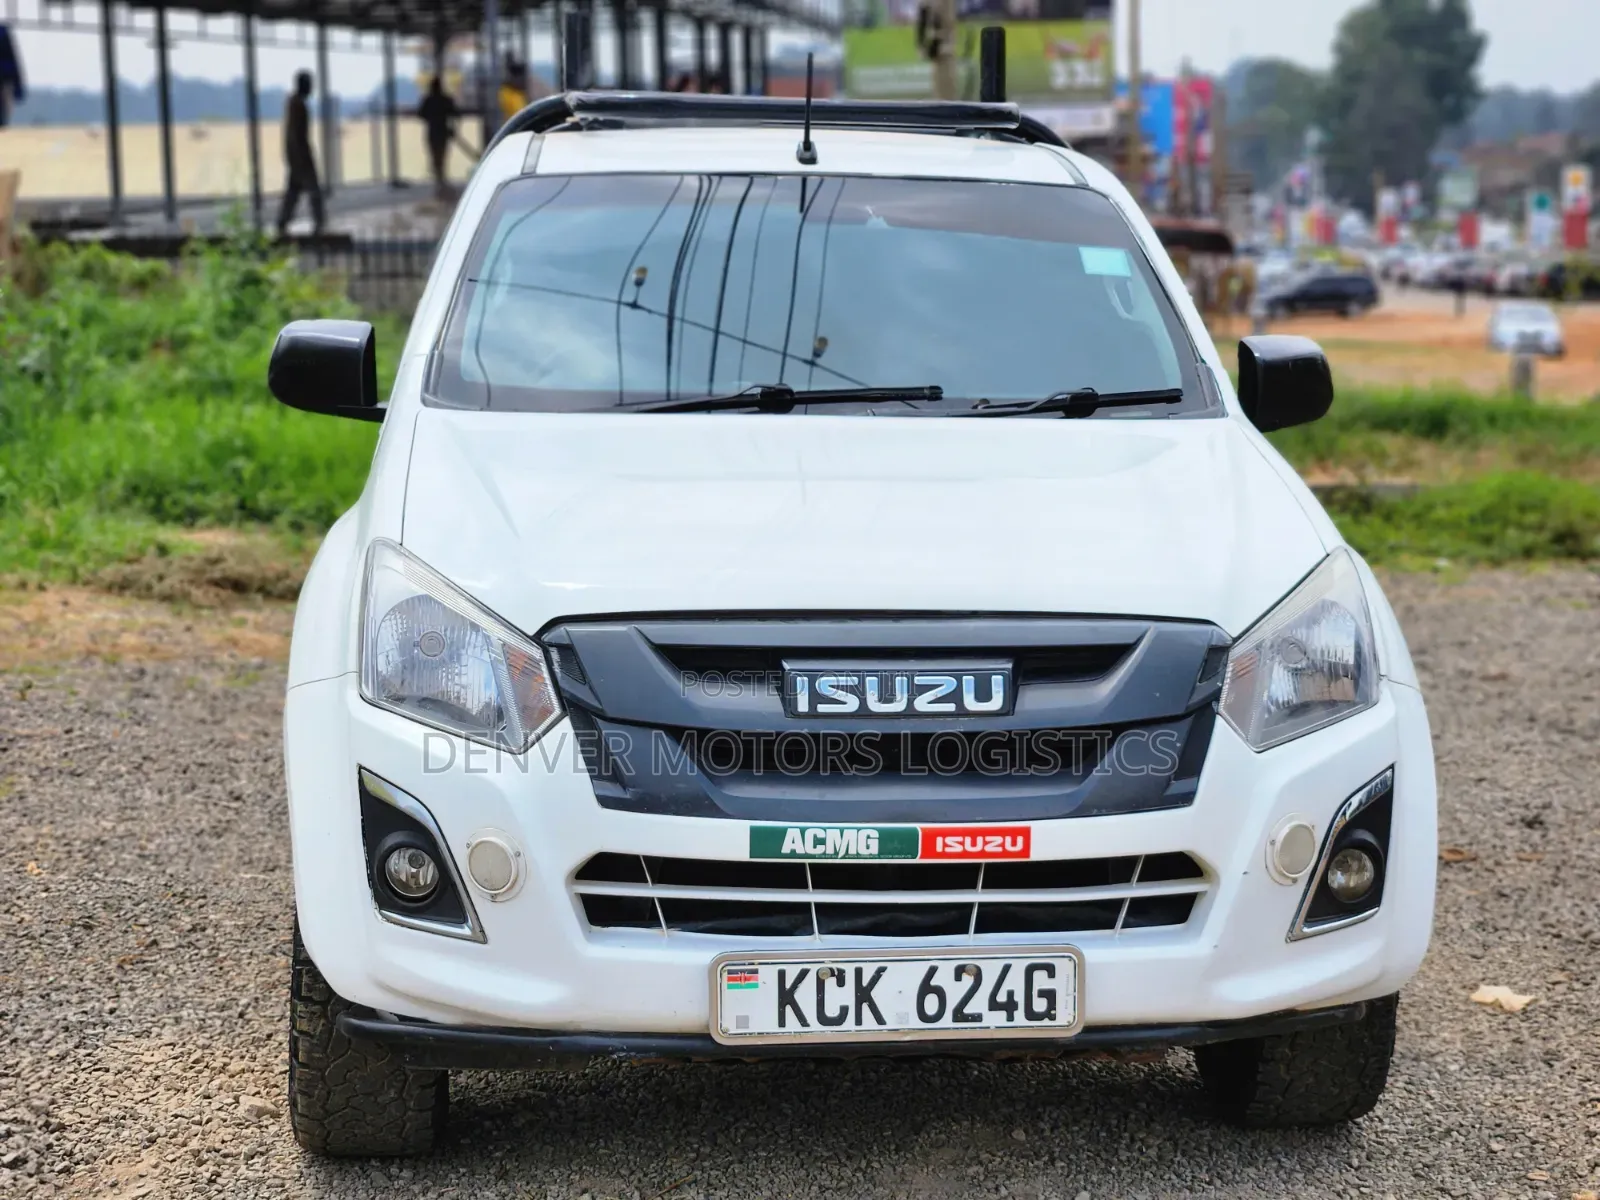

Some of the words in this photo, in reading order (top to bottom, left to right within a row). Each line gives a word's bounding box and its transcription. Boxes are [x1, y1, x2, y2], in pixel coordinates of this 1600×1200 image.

[796, 675, 1005, 713] ISUZU
[780, 827, 880, 859] ACMG
[935, 835, 1024, 853] ISUZU
[777, 965, 888, 1028] KCK
[916, 962, 1057, 1024] 624G
